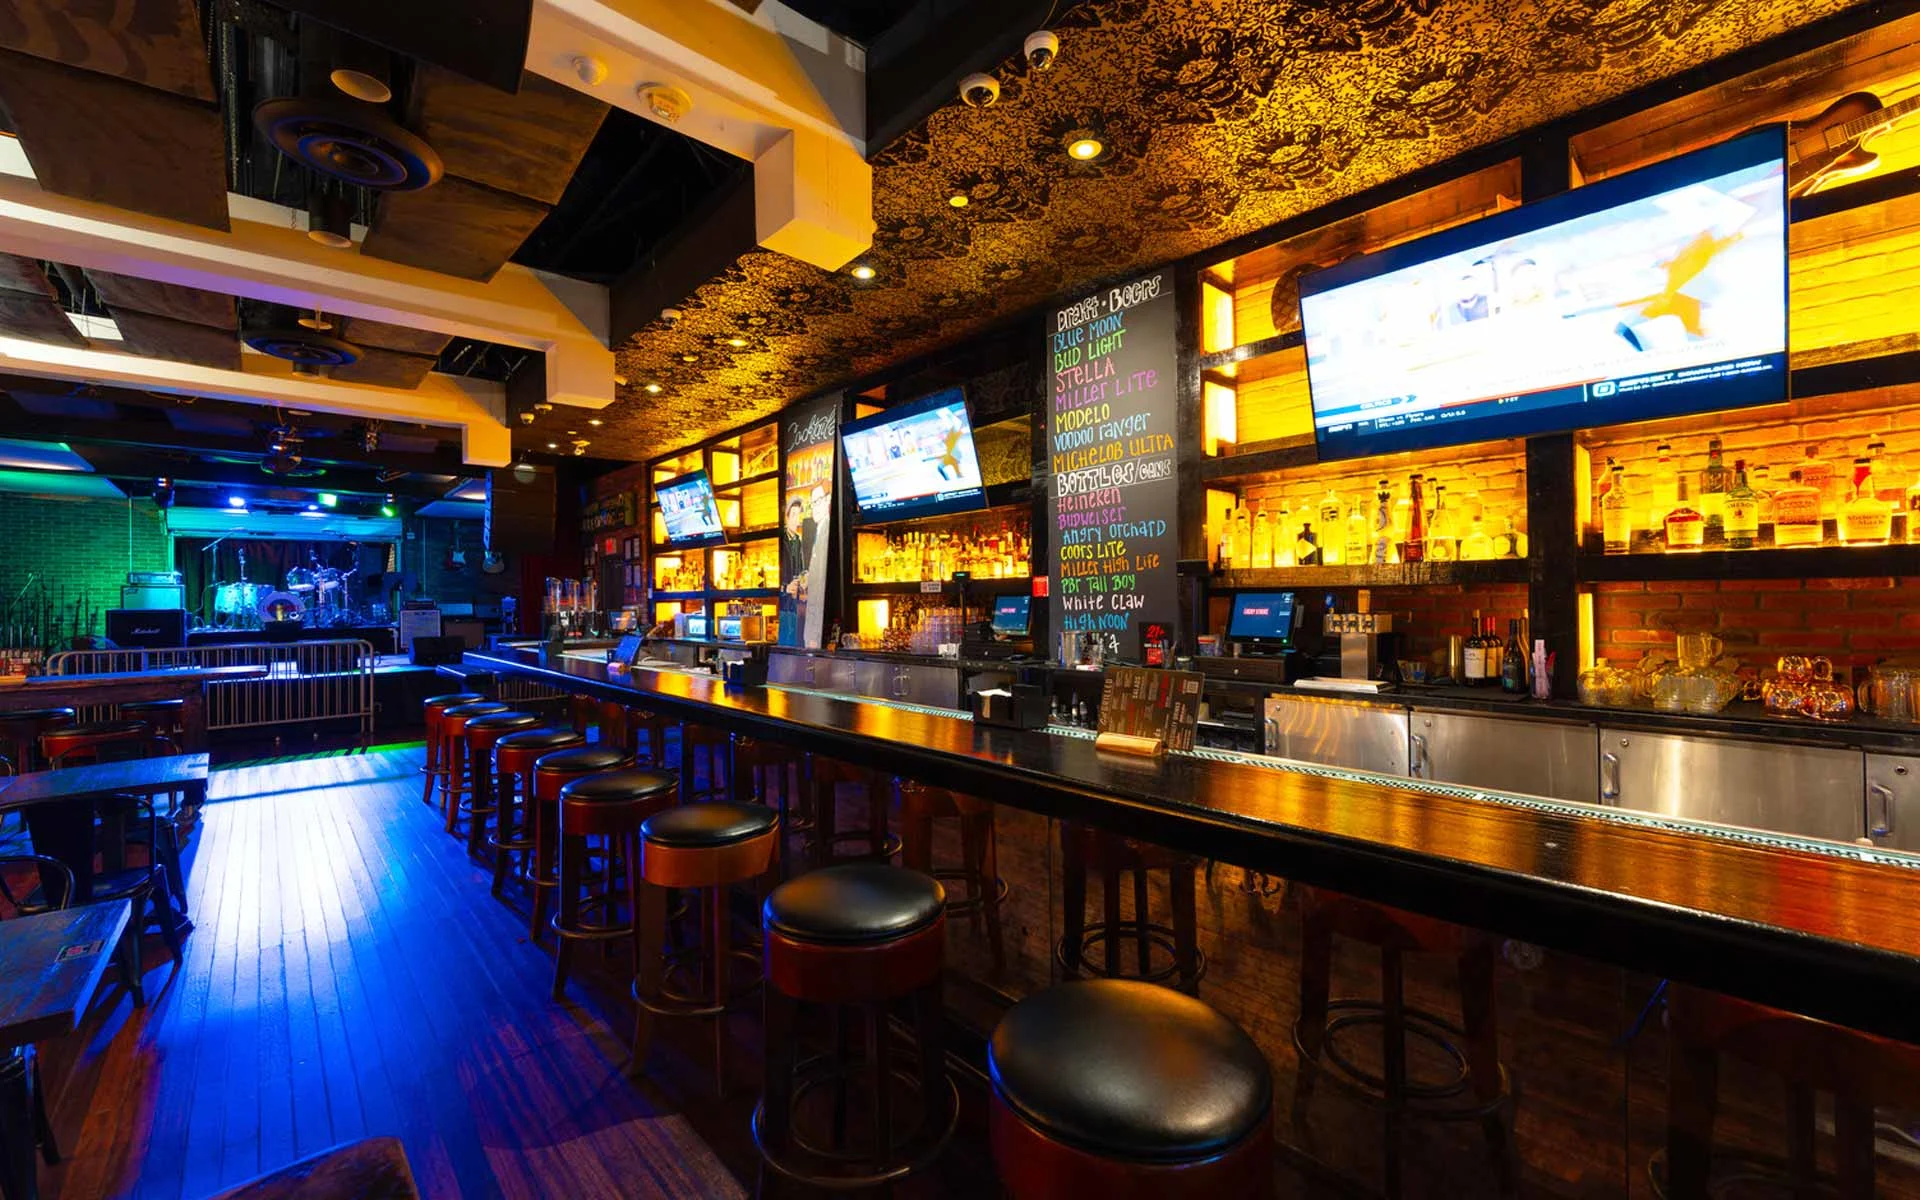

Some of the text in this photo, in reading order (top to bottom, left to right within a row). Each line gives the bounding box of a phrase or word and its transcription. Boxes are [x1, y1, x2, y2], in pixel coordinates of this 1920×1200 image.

[1089, 312, 1125, 340] MOON
[1055, 347, 1081, 373] BUD
[1053, 427, 1094, 452] VOODOO
[1098, 611, 1130, 631] NOON
